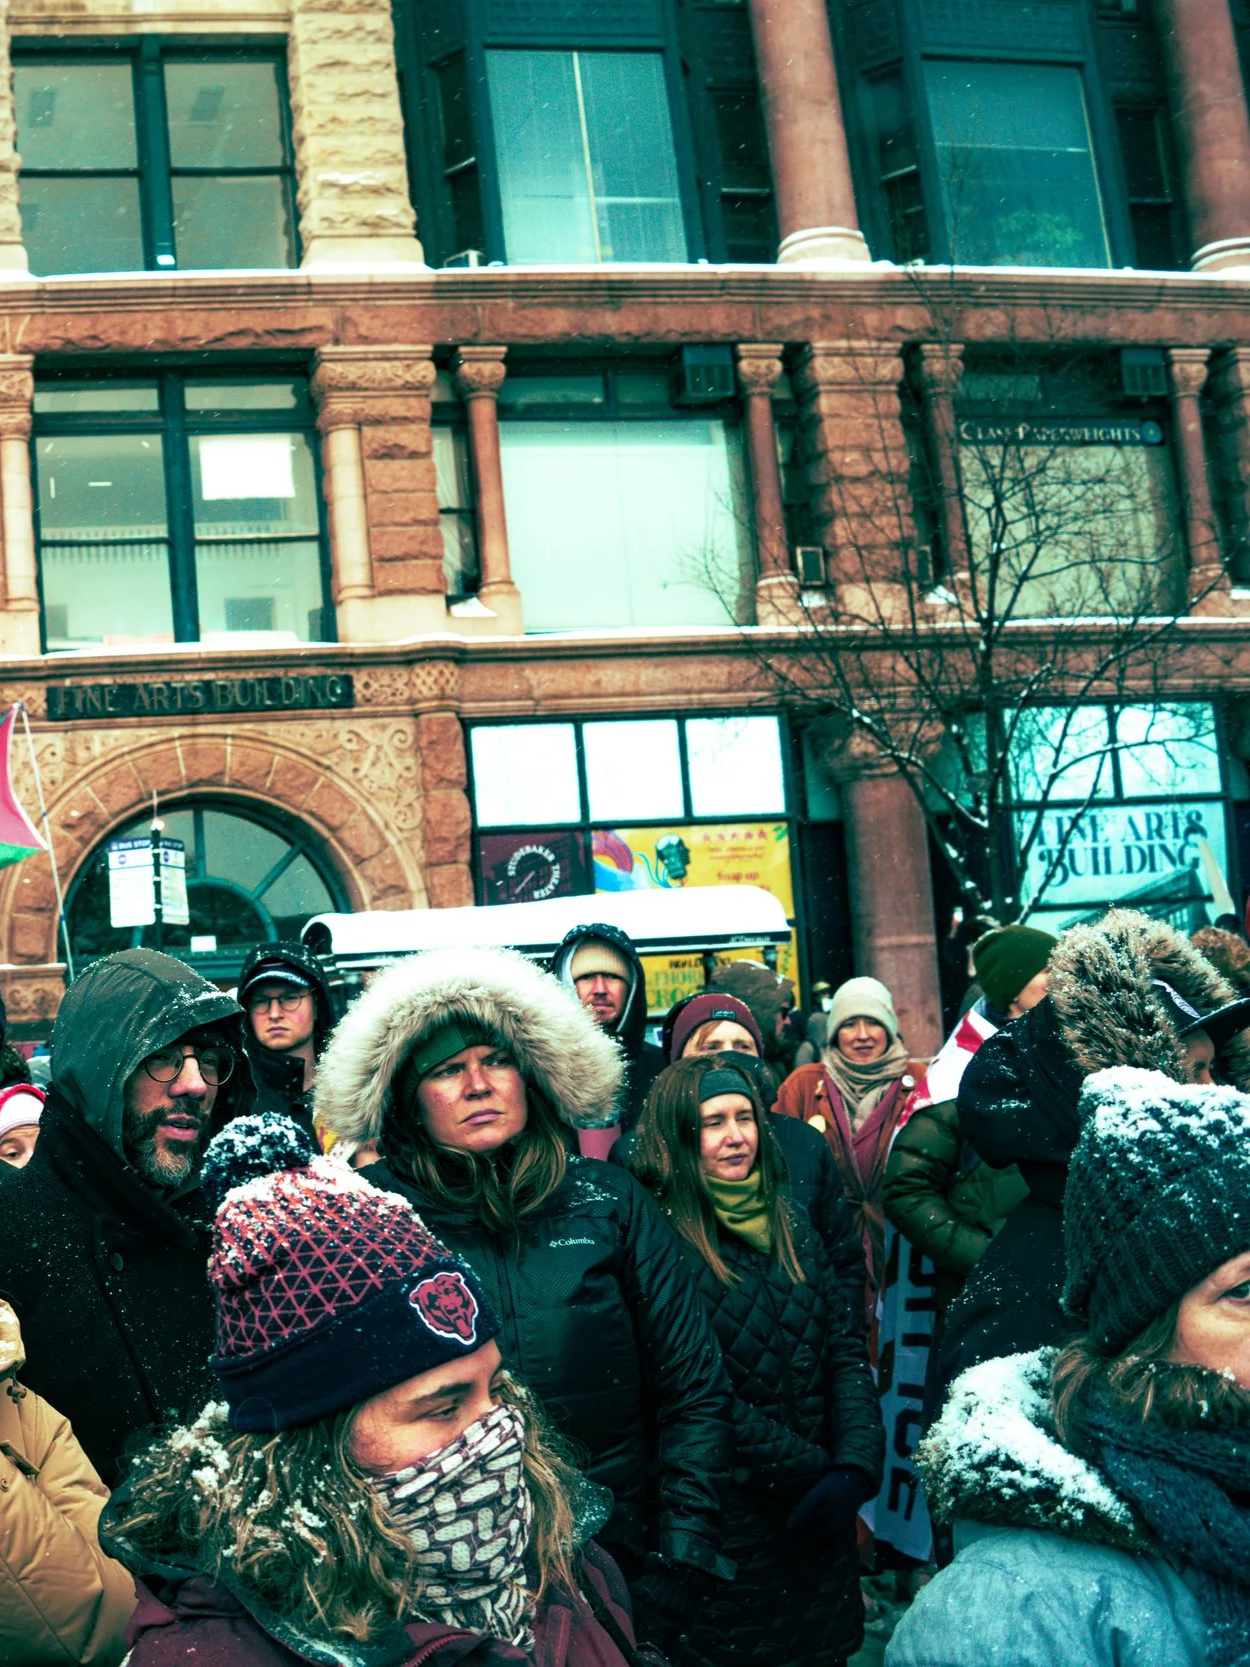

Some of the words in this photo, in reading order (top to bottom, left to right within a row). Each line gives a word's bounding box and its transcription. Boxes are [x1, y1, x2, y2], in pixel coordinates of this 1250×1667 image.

[56, 684, 121, 713] FINE
[133, 682, 203, 710] ARTS
[214, 676, 341, 707] BUILDING
[1038, 842, 1200, 889] BUILDING
[558, 1236, 595, 1247] Columbia
